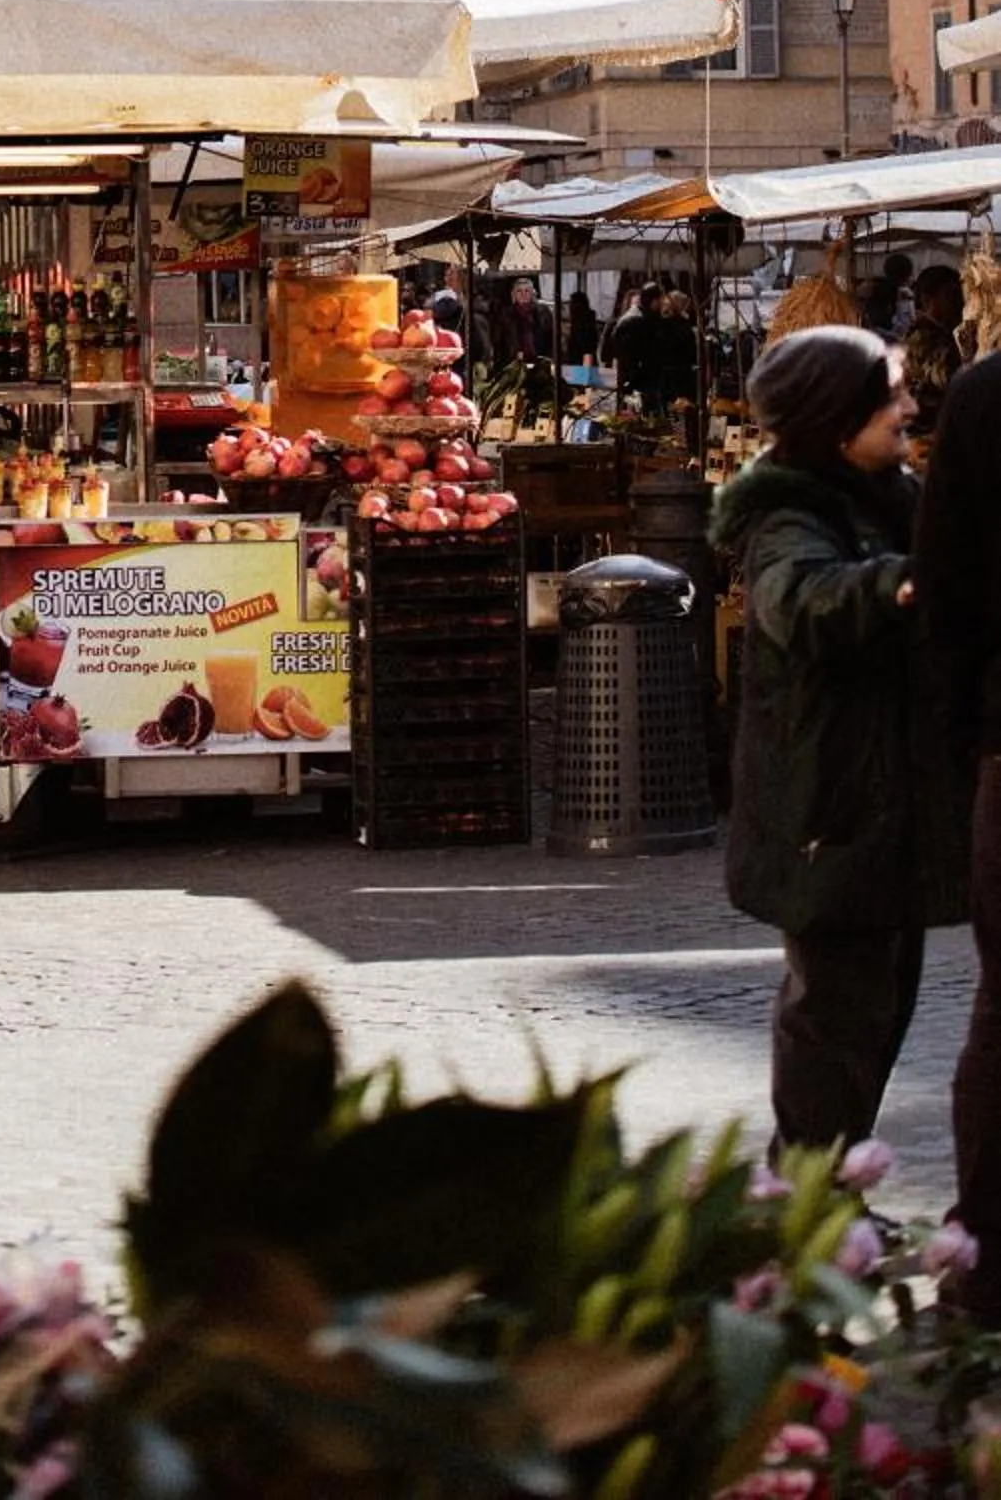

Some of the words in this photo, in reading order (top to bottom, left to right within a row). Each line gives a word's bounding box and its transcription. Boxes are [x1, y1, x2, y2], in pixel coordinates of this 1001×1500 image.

[249, 141, 325, 158] ORANGE
[249, 159, 298, 176] JUICE
[32, 567, 165, 592] SPREMUTE
[32, 592, 61, 617] DI
[64, 590, 225, 617] MELOGRANO
[77, 626, 171, 642] Pomegranate
[173, 625, 208, 639] Juice
[271, 632, 337, 652] FRESH
[77, 644, 110, 657] Fruit
[113, 644, 141, 659] Cup
[77, 661, 105, 674] and
[107, 661, 160, 676] Orange
[162, 659, 197, 673] Juice
[271, 654, 337, 674] FRESH
